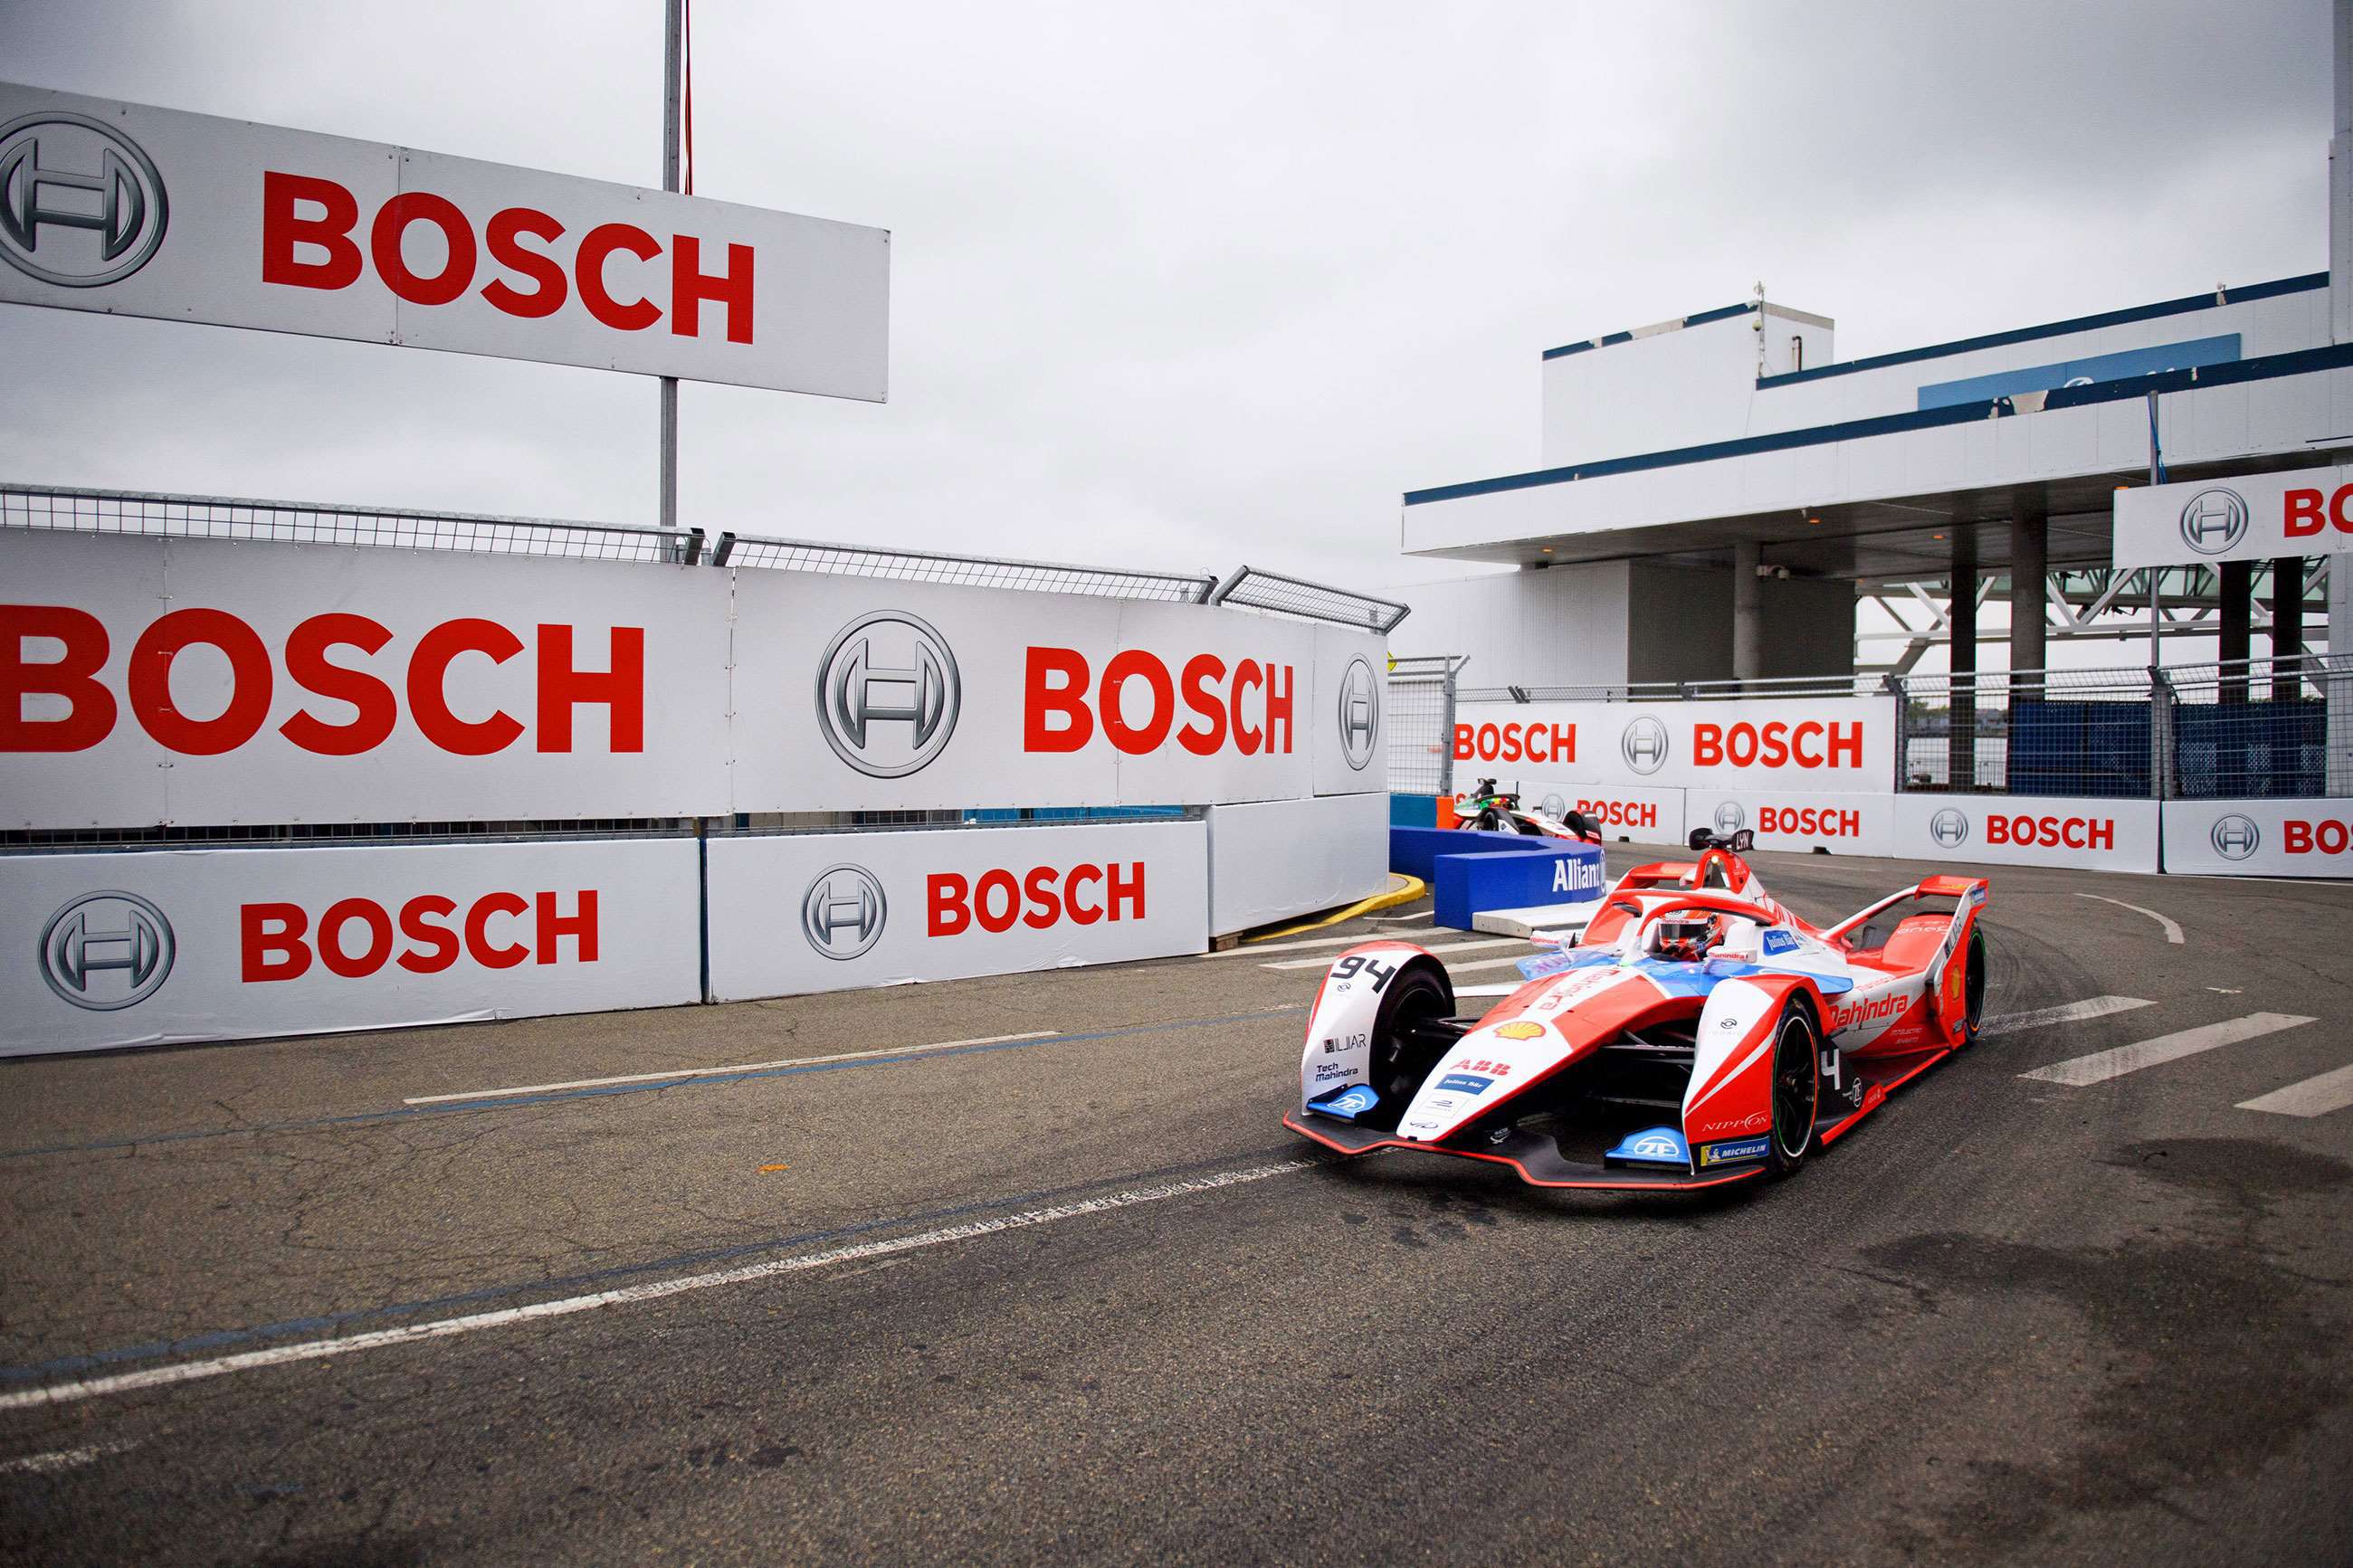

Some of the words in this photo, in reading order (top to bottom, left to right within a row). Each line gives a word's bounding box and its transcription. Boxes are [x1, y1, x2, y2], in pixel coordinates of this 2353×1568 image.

[263, 171, 754, 344] BOSCH
[0, 605, 644, 755] BOSCH
[1024, 646, 1293, 756] BOSCH
[1453, 723, 1577, 763] BOSCH
[1693, 720, 1863, 768] BOSCH
[1758, 807, 1860, 837] BOSCH
[1986, 814, 2115, 851] BOSCH
[2283, 819, 2353, 855] BO
[1735, 832, 1750, 851] LYN
[927, 861, 1146, 937] BOSCH
[241, 889, 599, 984] BOSCH
[1329, 955, 1396, 994] 94
[1315, 1068, 1358, 1082] Mahindra
[1317, 1062, 1338, 1073] Tech
[1449, 1059, 1511, 1076] ABB
[1702, 1110, 1767, 1132] NIPPON
[1721, 1144, 1767, 1158] MICHELIN
